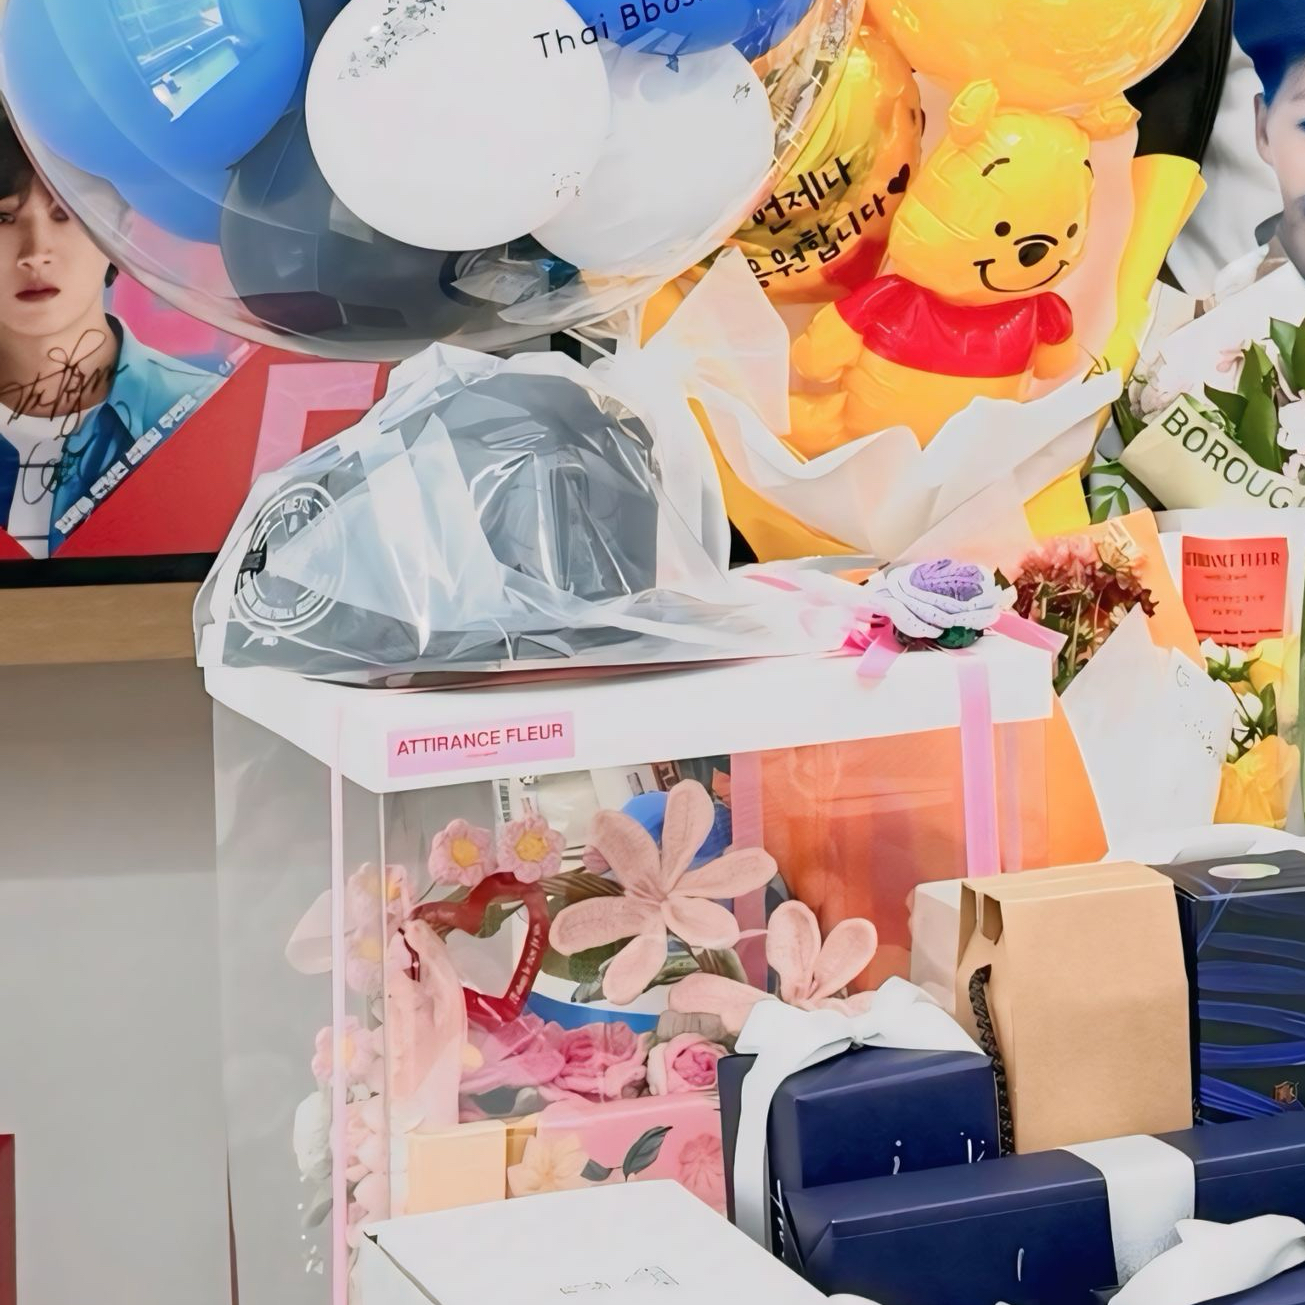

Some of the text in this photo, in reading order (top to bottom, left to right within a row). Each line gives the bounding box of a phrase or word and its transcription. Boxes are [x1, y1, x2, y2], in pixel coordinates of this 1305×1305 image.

[533, 13, 609, 59] Thai
[752, 156, 852, 236] 언제나
[396, 723, 563, 756] ATTIRANCE FLEUR
